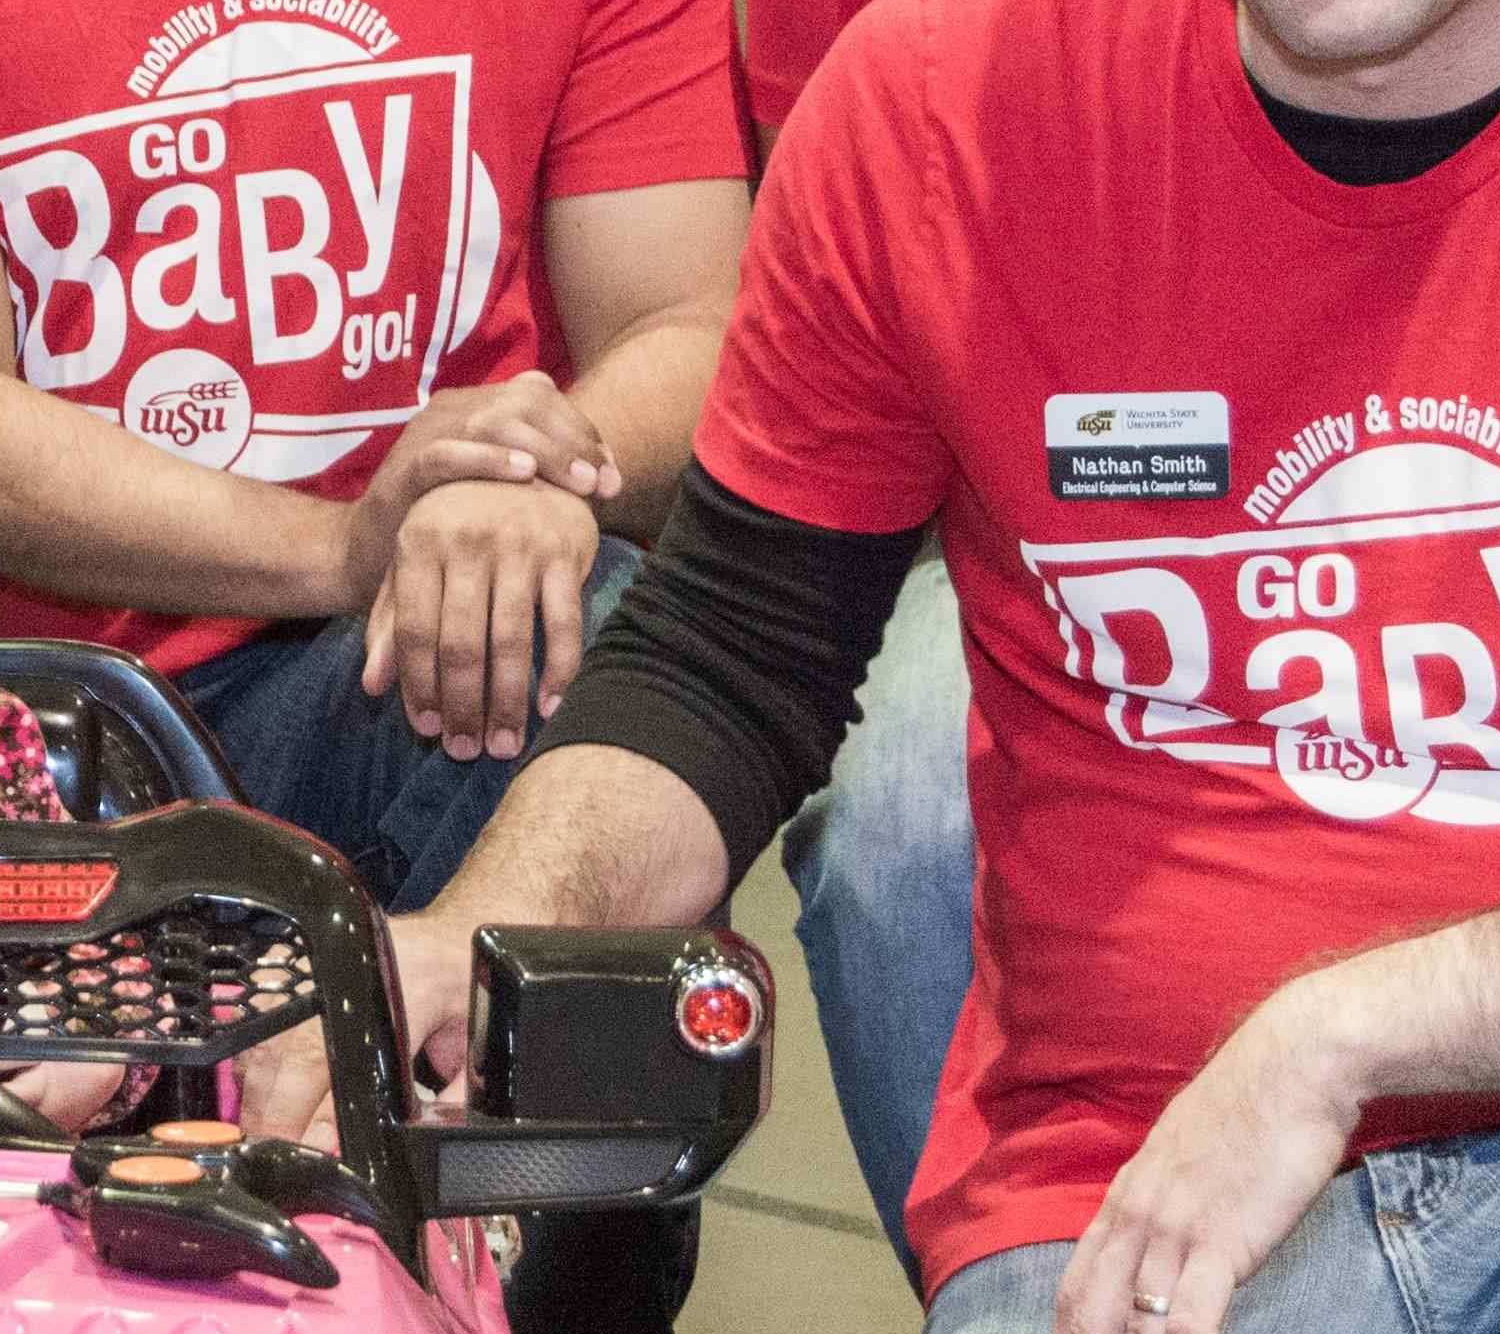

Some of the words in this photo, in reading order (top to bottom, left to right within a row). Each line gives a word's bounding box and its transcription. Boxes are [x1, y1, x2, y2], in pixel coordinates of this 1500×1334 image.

[127, 1, 219, 98] mobility
[129, 118, 226, 180] GO
[342, 294, 416, 380] go!
[1127, 420, 1183, 429] UNIVERSITY
[1062, 481, 1098, 494] Electrical
[1100, 481, 1140, 496] Engineering
[1142, 480, 1149, 492] &
[1150, 480, 1185, 496] Computer
[1188, 479, 1217, 492] Science
[1072, 456, 1143, 475] Nathan
[1151, 455, 1206, 474] Smith
[1243, 413, 1354, 524] mobility
[1364, 394, 1391, 433] &
[1237, 553, 1356, 620] GO
